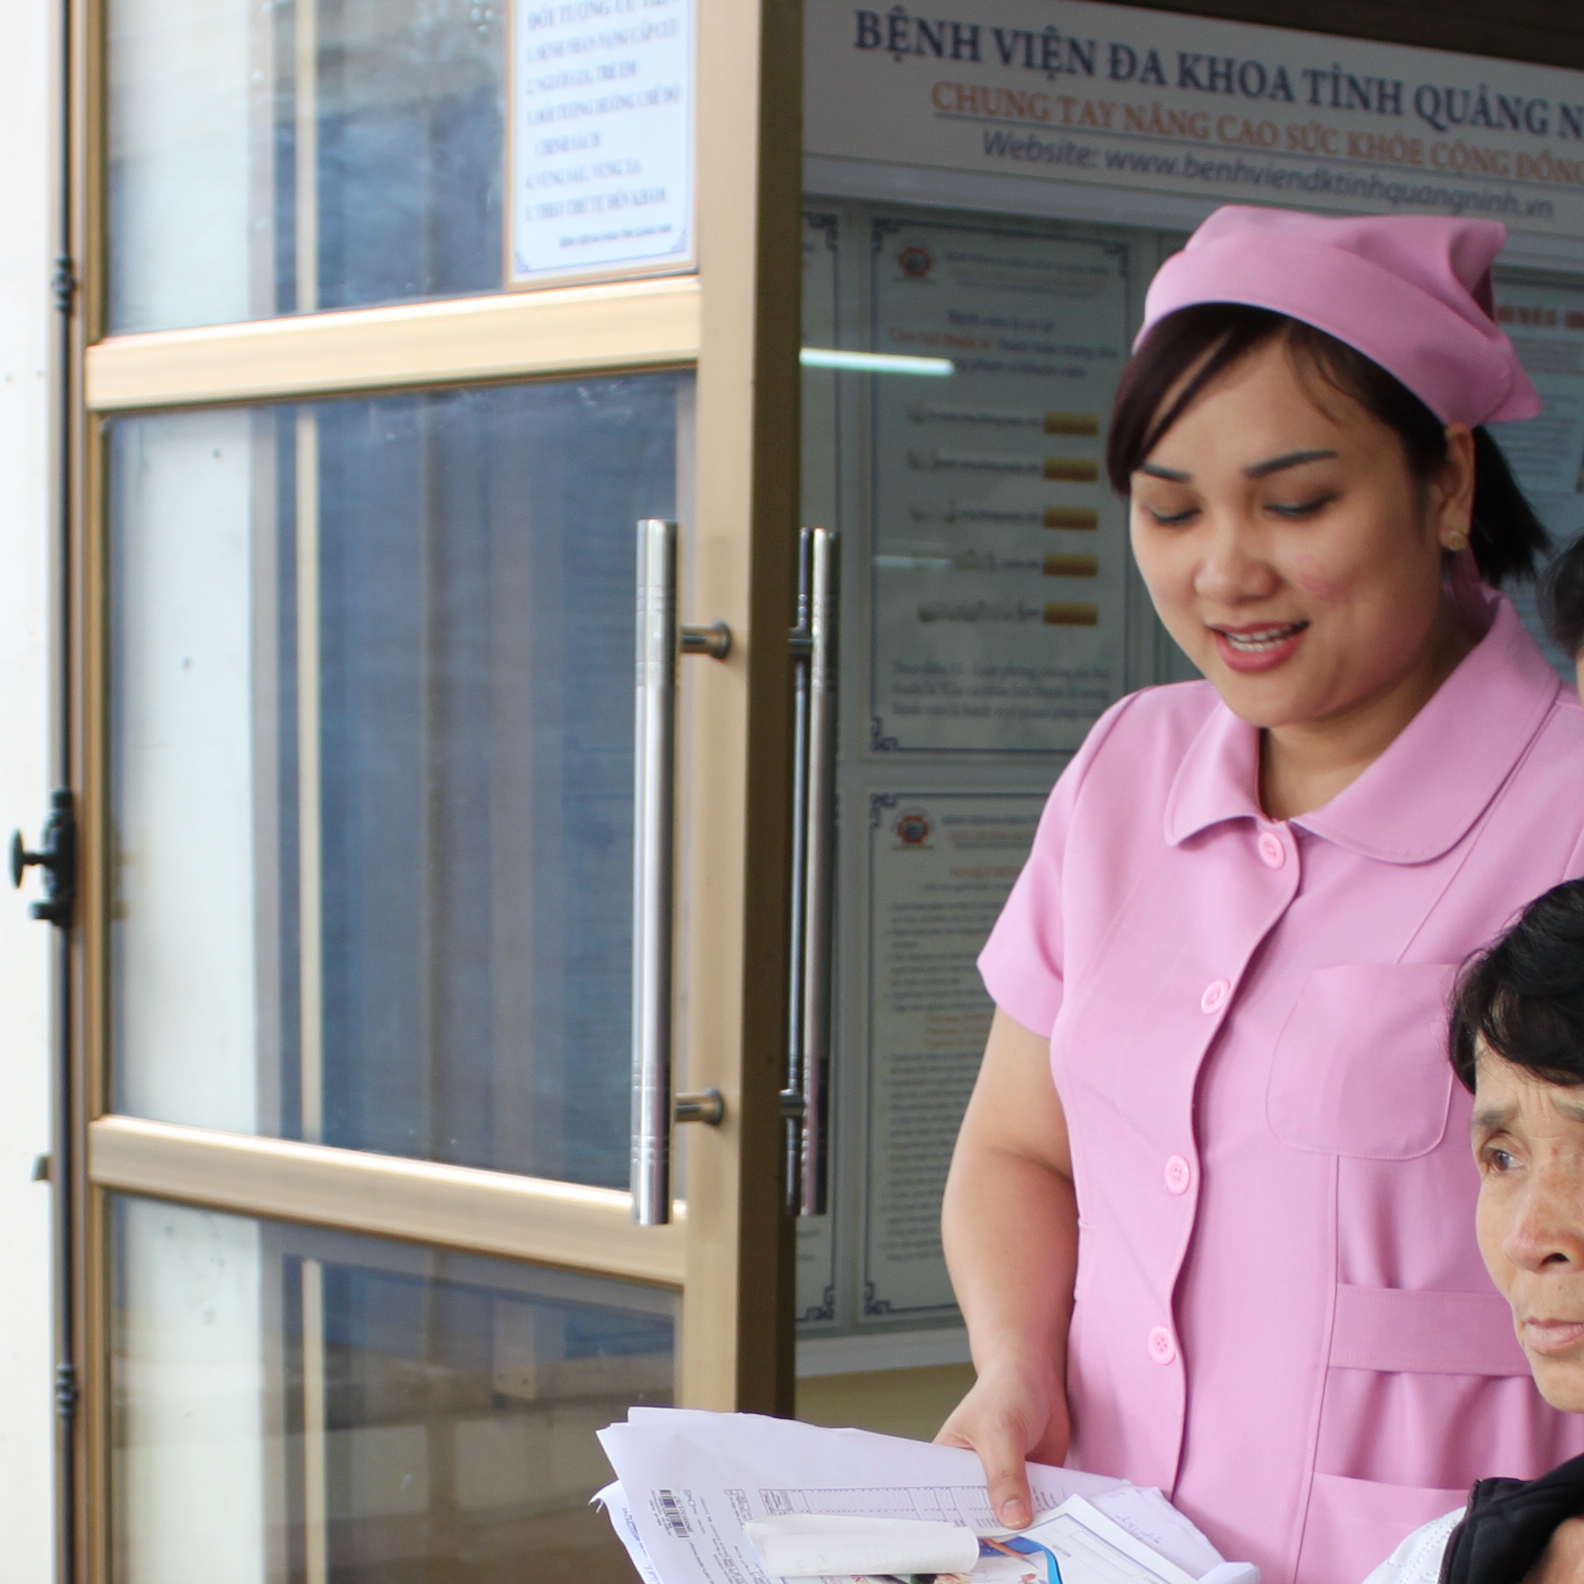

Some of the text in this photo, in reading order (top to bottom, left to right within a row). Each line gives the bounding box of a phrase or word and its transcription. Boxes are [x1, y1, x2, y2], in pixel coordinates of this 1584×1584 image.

[854, 4, 982, 63] BỆNH
[992, 24, 1096, 81] VIỆN
[1107, 42, 1167, 86] ĐA
[1177, 52, 1296, 102] KHOA
[1302, 62, 1404, 117] TỈNH
[1414, 82, 1550, 134] QUẢNG
[931, 80, 1052, 122] CHUNG
[1056, 96, 1118, 130] TAY
[1123, 101, 1210, 142] NÂNG
[1216, 115, 1279, 149] CAO
[983, 127, 1097, 168] Website:
